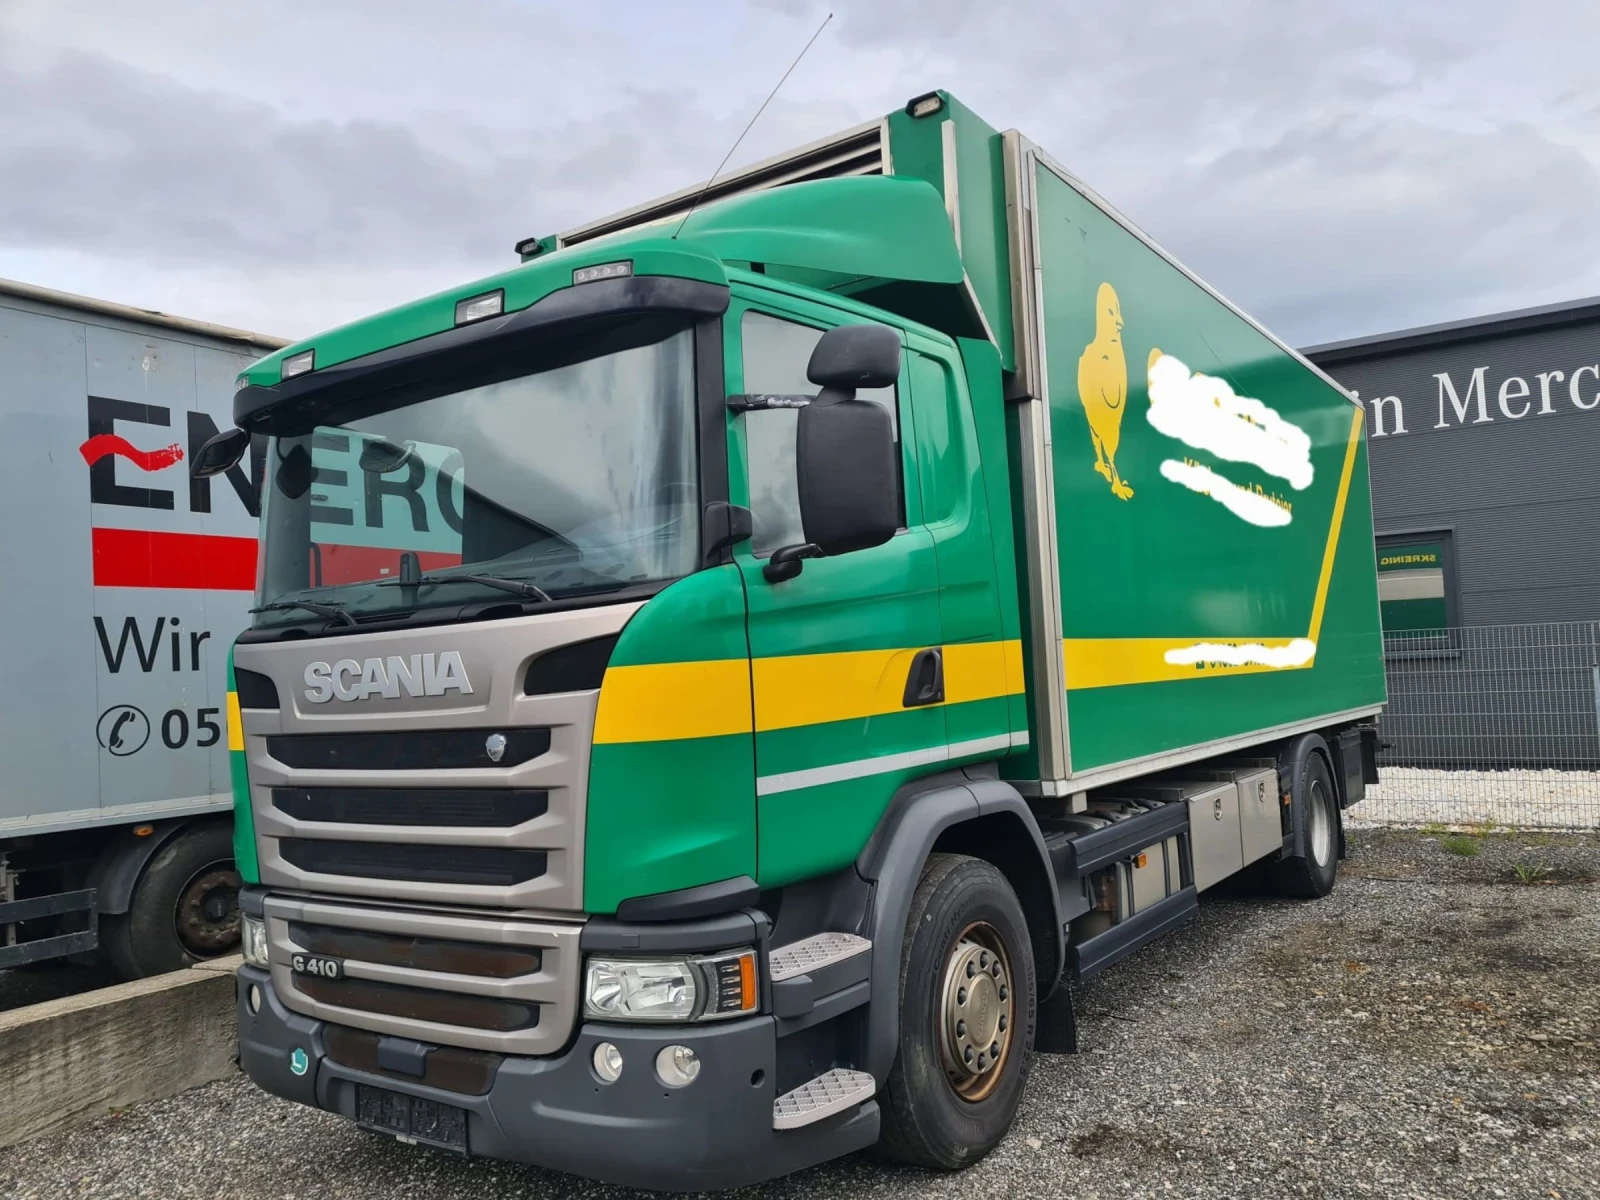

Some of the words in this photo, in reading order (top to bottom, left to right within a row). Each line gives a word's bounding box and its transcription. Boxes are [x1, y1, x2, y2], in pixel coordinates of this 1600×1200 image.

[1432, 364, 1600, 429] Merc
[93, 616, 211, 673] Wir
[303, 651, 475, 704] SCANIA
[292, 955, 305, 972] G
[306, 958, 338, 978] 410
[1026, 1024, 1034, 1036] R
[1019, 1040, 1032, 1078] 22.5
